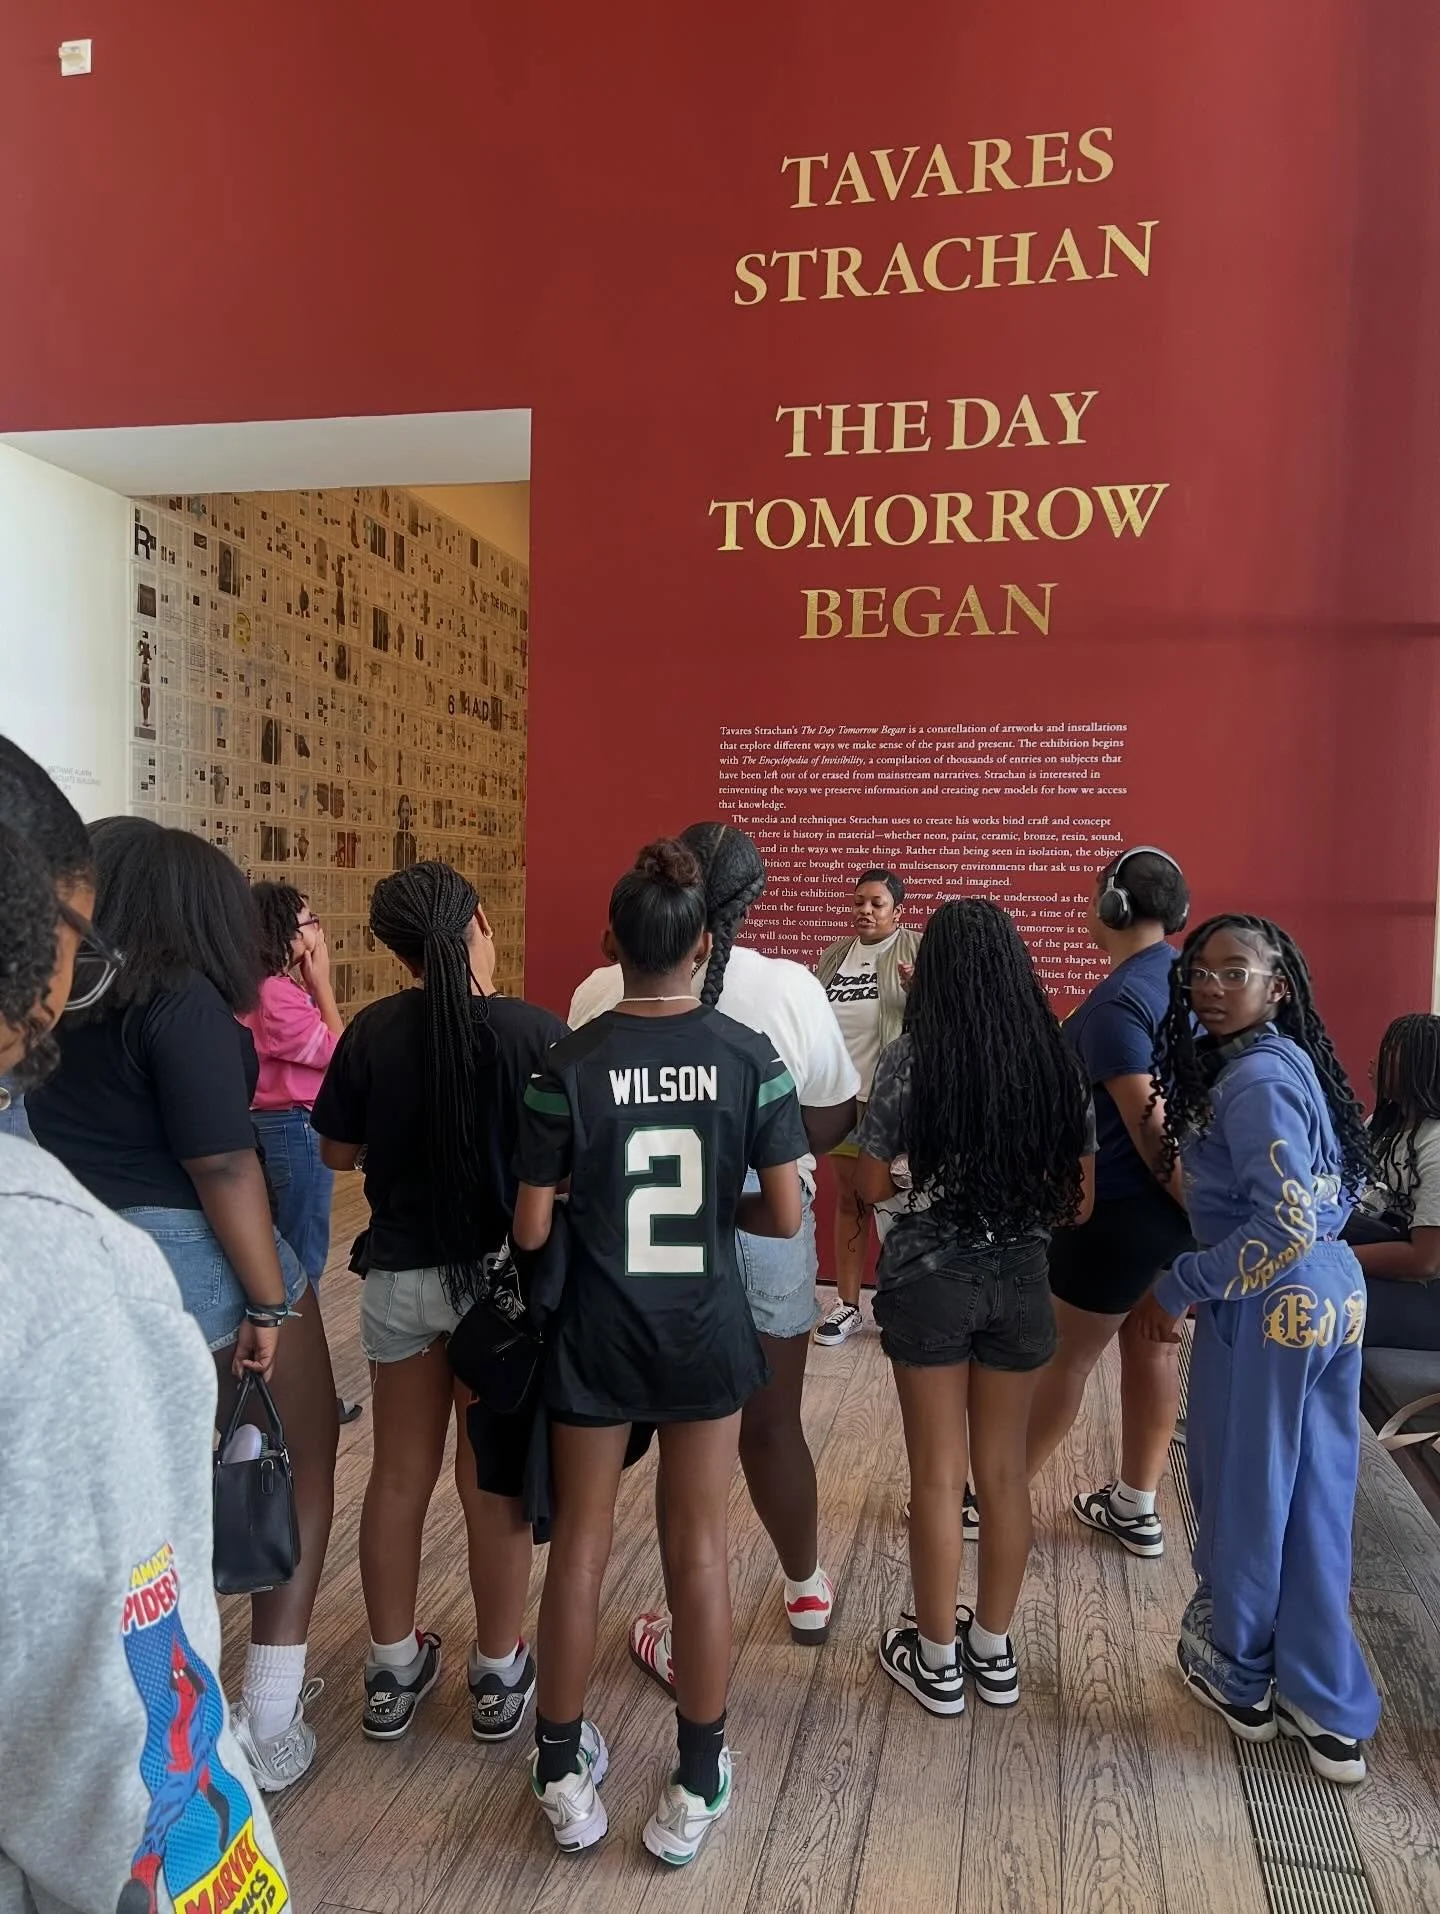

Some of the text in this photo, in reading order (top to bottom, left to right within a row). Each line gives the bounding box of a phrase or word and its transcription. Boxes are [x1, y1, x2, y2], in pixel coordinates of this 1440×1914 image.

[781, 126, 1116, 209] TAVARES
[734, 220, 1160, 306] STRACHAN
[775, 390, 1098, 457] THE DAY
[708, 483, 1170, 552] TOMORROW
[799, 582, 1059, 640] BEGAN
[720, 722, 1128, 737] Tavares Strachan's The Day Tomorrow Began constellation artworks and installations
[720, 737, 1124, 752] that explore different ways make sense the past and present. The exhibition begins
[720, 753, 1122, 767] with The Encyclopedia Invisibility, compilation thousands entries subjects that
[719, 768, 1088, 779] have been left out erased from mainstream narratives. Strachan interested
[718, 783, 768, 797] reinventing
[770, 783, 784, 794] the
[786, 787, 808, 797] ways
[824, 787, 862, 797] preserve
[864, 783, 919, 794] information
[920, 784, 938, 794] and
[941, 784, 980, 797] creating
[1003, 784, 1038, 794] models
[1040, 784, 1055, 794] for
[1058, 784, 1078, 794] how
[718, 798, 786, 811] that knowledge.
[732, 813, 749, 824] The
[751, 813, 778, 824] media
[780, 813, 797, 824] and
[800, 813, 847, 827] techniques
[850, 814, 888, 824] Strachan
[925, 816, 952, 825] create
[955, 814, 969, 825] his
[971, 814, 1000, 825] works
[1002, 814, 1025, 825] bind
[1027, 815, 1049, 825] craft
[1051, 815, 1070, 825] and
[1072, 817, 1111, 828] concept
[758, 828, 781, 838] there
[793, 828, 824, 841] history
[924, 832, 950, 841] neon,
[952, 829, 979, 843] paint,
[981, 830, 1021, 842] ceramic,
[1023, 830, 1059, 842] bronze,
[1061, 830, 1088, 842] resin,
[1090, 830, 1124, 842] sound,
[790, 842, 1092, 857] the ways make things. Rather than being seen isolation, the
[809, 858, 844, 871] brought
[847, 858, 884, 872] together
[900, 859, 958, 872] multisensory
[960, 860, 1026, 871] environments
[1028, 861, 1048, 871] that
[1050, 861, 1066, 871] ask
[822, 872, 843, 883] lived
[902, 874, 942, 884] observed
[946, 874, 963, 885] and
[966, 875, 1012, 888] imagined.
[781, 886, 798, 897] this
[1004, 891, 1058, 902] understood
[1073, 892, 1090, 903] the
[754, 900, 777, 911] when
[780, 901, 794, 911] the
[796, 901, 824, 912] future
[908, 904, 924, 914] the
[1039, 906, 1062, 917] time
[744, 916, 780, 928] suggests
[782, 915, 796, 926] the
[798, 916, 848, 927] continuous
[1016, 923, 1064, 932] tomorrow
[760, 929, 776, 940] will
[1045, 937, 1061, 947] the
[1063, 939, 1083, 951] past
[761, 943, 778, 954] and
[780, 944, 798, 955] how
[1040, 954, 1062, 963] turn
[1064, 954, 1097, 967] shapes
[1067, 969, 1082, 979] for
[1084, 969, 1099, 980] the
[1063, 984, 1086, 995] This
[609, 1065, 717, 1105] WILSON
[625, 1125, 708, 1276] 2
[373, 1692, 392, 1701] NIKE
[481, 1695, 500, 1704] NIKE
